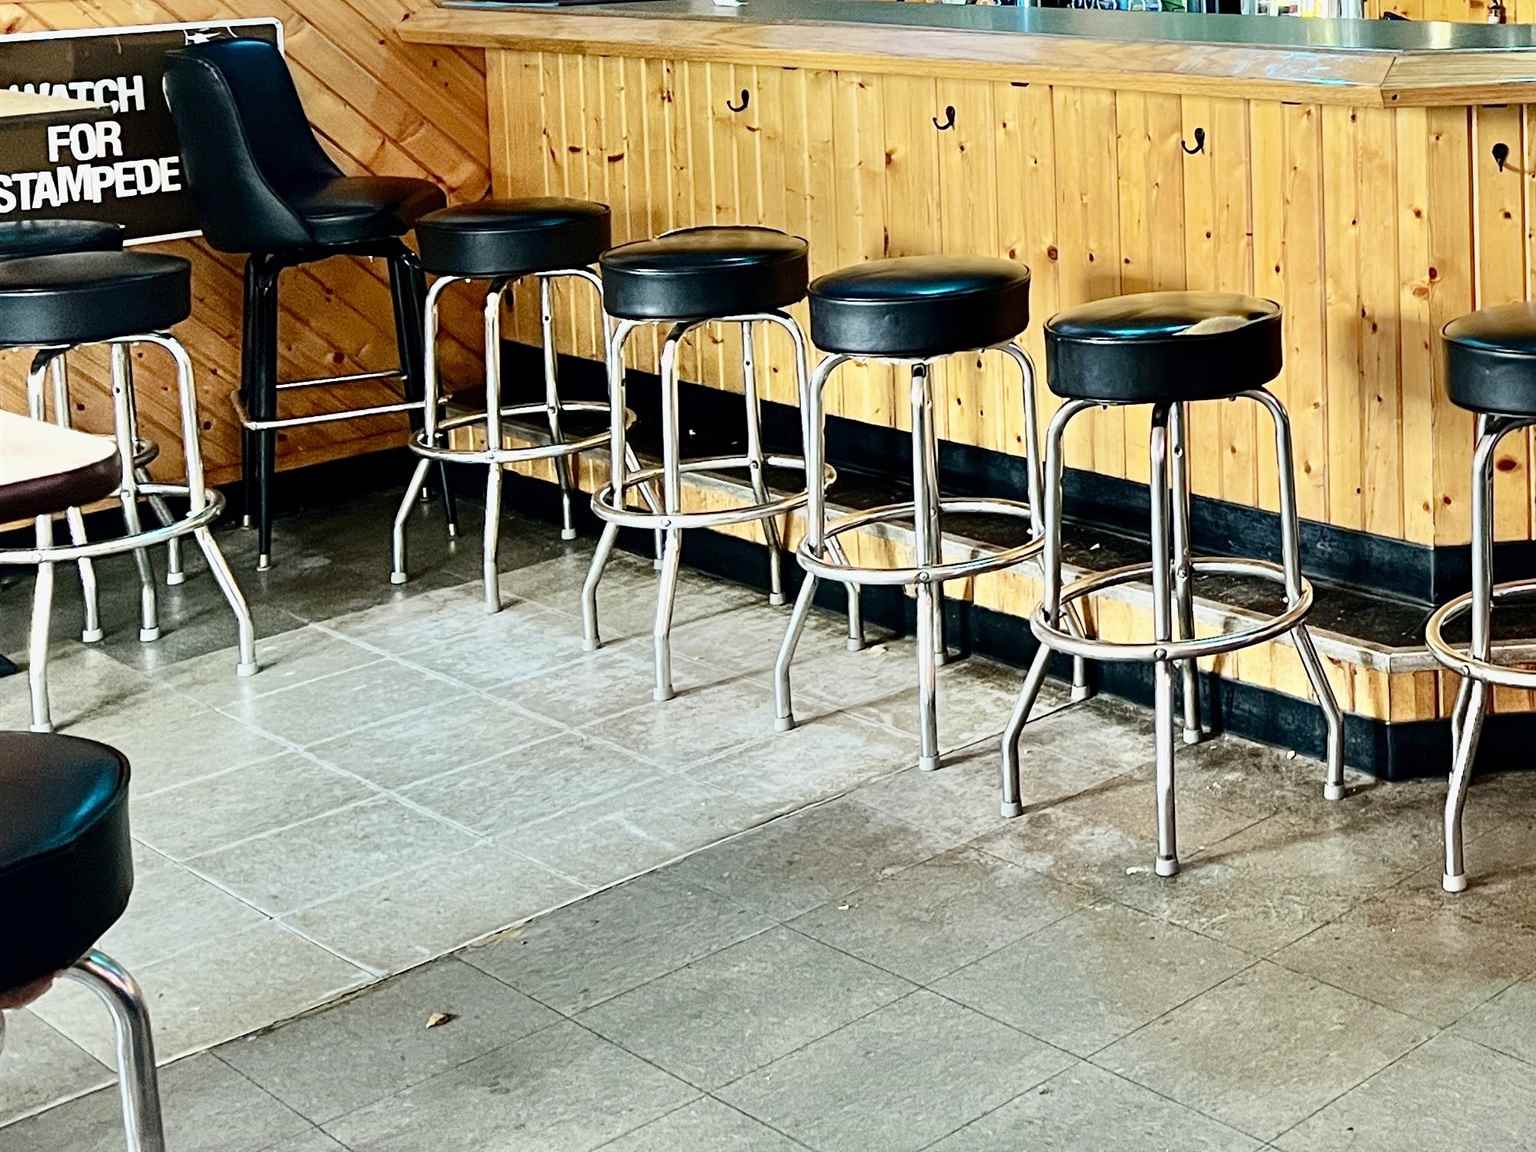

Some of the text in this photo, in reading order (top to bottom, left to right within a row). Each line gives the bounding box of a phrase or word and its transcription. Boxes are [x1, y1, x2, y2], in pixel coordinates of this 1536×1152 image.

[9, 75, 146, 114] TCH
[47, 121, 123, 162] FOR
[0, 156, 182, 214] STAMPEDE
